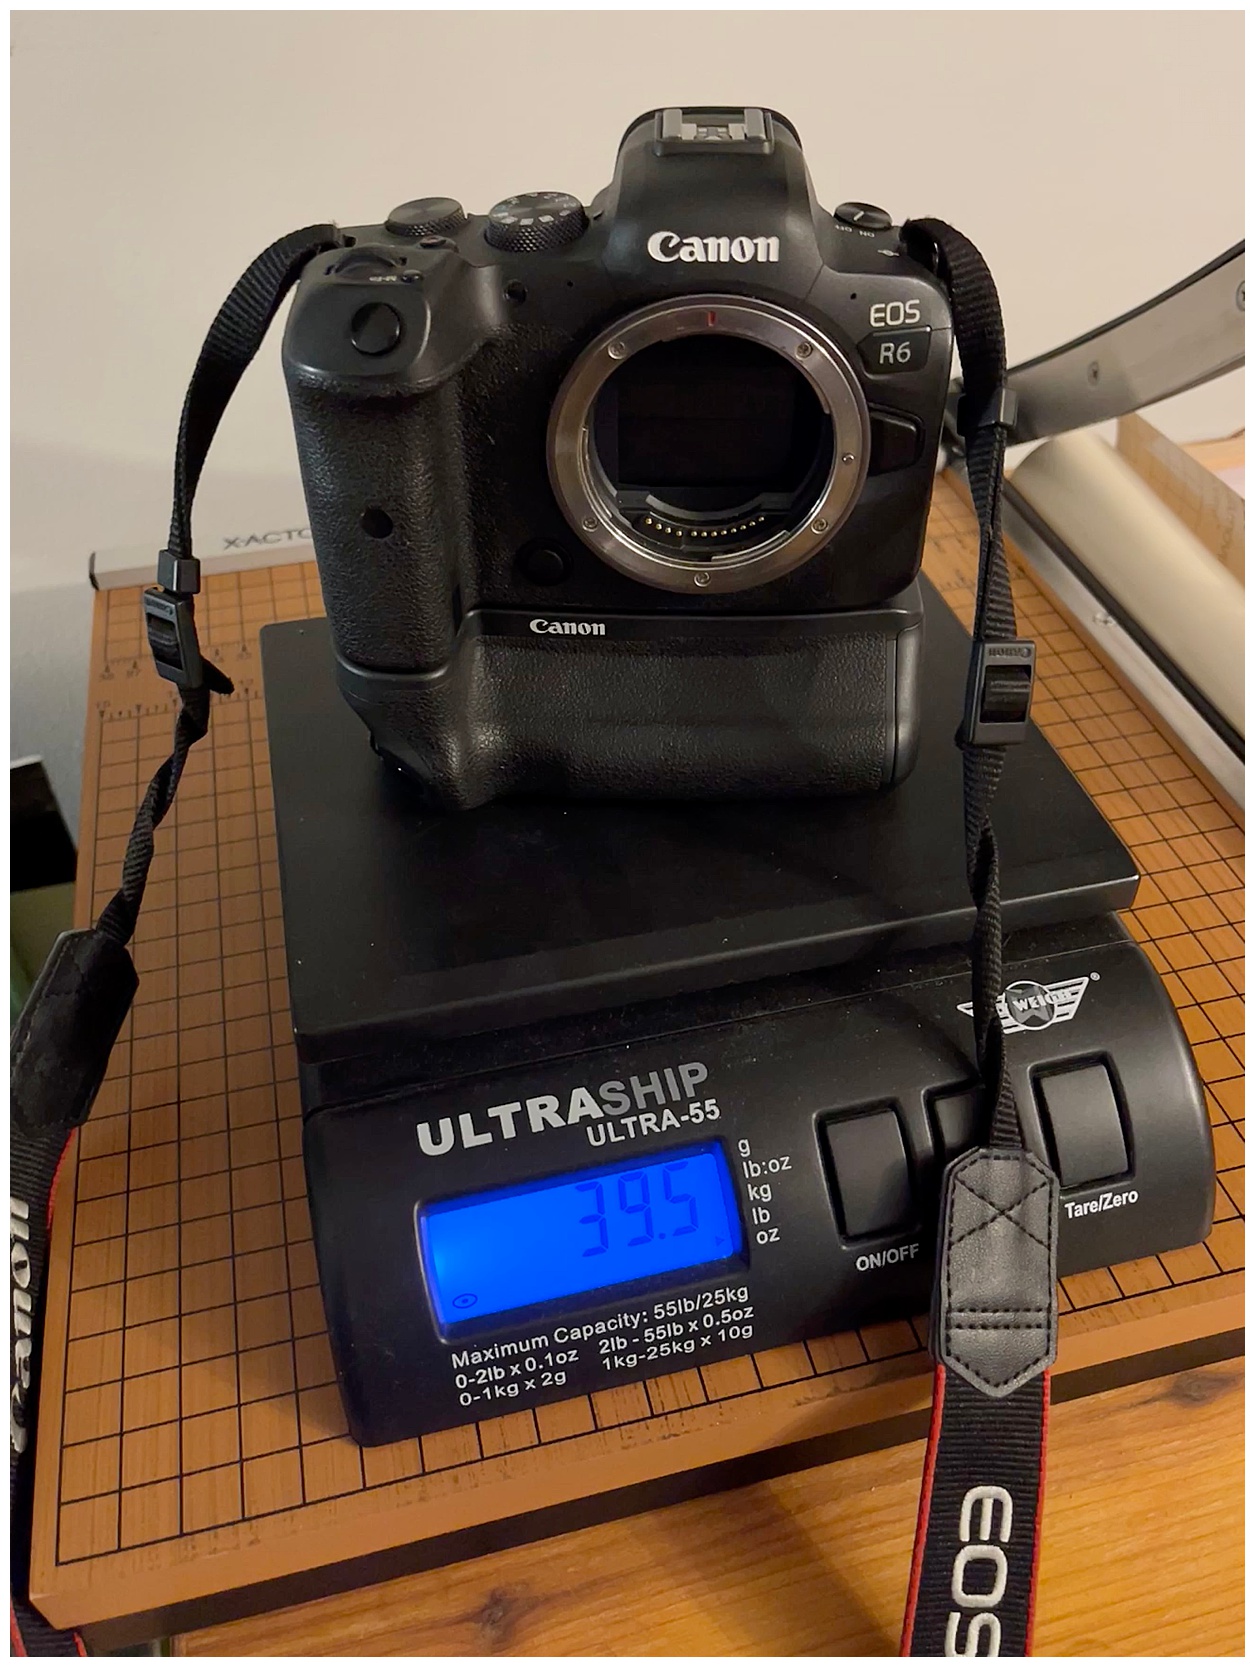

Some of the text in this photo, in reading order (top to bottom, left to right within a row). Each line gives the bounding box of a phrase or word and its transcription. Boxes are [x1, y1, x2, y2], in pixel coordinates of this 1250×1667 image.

[646, 230, 780, 263] Canon
[868, 299, 922, 327] EOS
[878, 338, 912, 366] R6
[528, 618, 607, 636] Canon
[416, 1062, 709, 1156] ULTRASHIP
[586, 1099, 721, 1148] ULTRA-55
[738, 1138, 751, 1157] g
[742, 1156, 793, 1179] lb:oz
[747, 1182, 773, 1202] kg
[1065, 1189, 1139, 1220] Tare/Zero
[575, 1161, 699, 1258] 39.5
[752, 1206, 771, 1226] lb
[756, 1226, 781, 1246] oz
[856, 1243, 920, 1272] ON/OFF
[451, 1286, 750, 1370] Maximum Capacity: 55lb/25kg
[455, 1366, 506, 1390] 0-2lb
[509, 1363, 522, 1377] x
[524, 1349, 579, 1373] 0.1oz
[598, 1335, 628, 1355] 2lb
[643, 1322, 684, 1343] 55lb
[688, 1319, 699, 1333] x
[702, 1306, 755, 1329] 0.5oz
[459, 1325, 754, 1406] 0-1kg x 2g 1kg-25kg x 10g
[944, 1485, 1014, 1657] EOS
